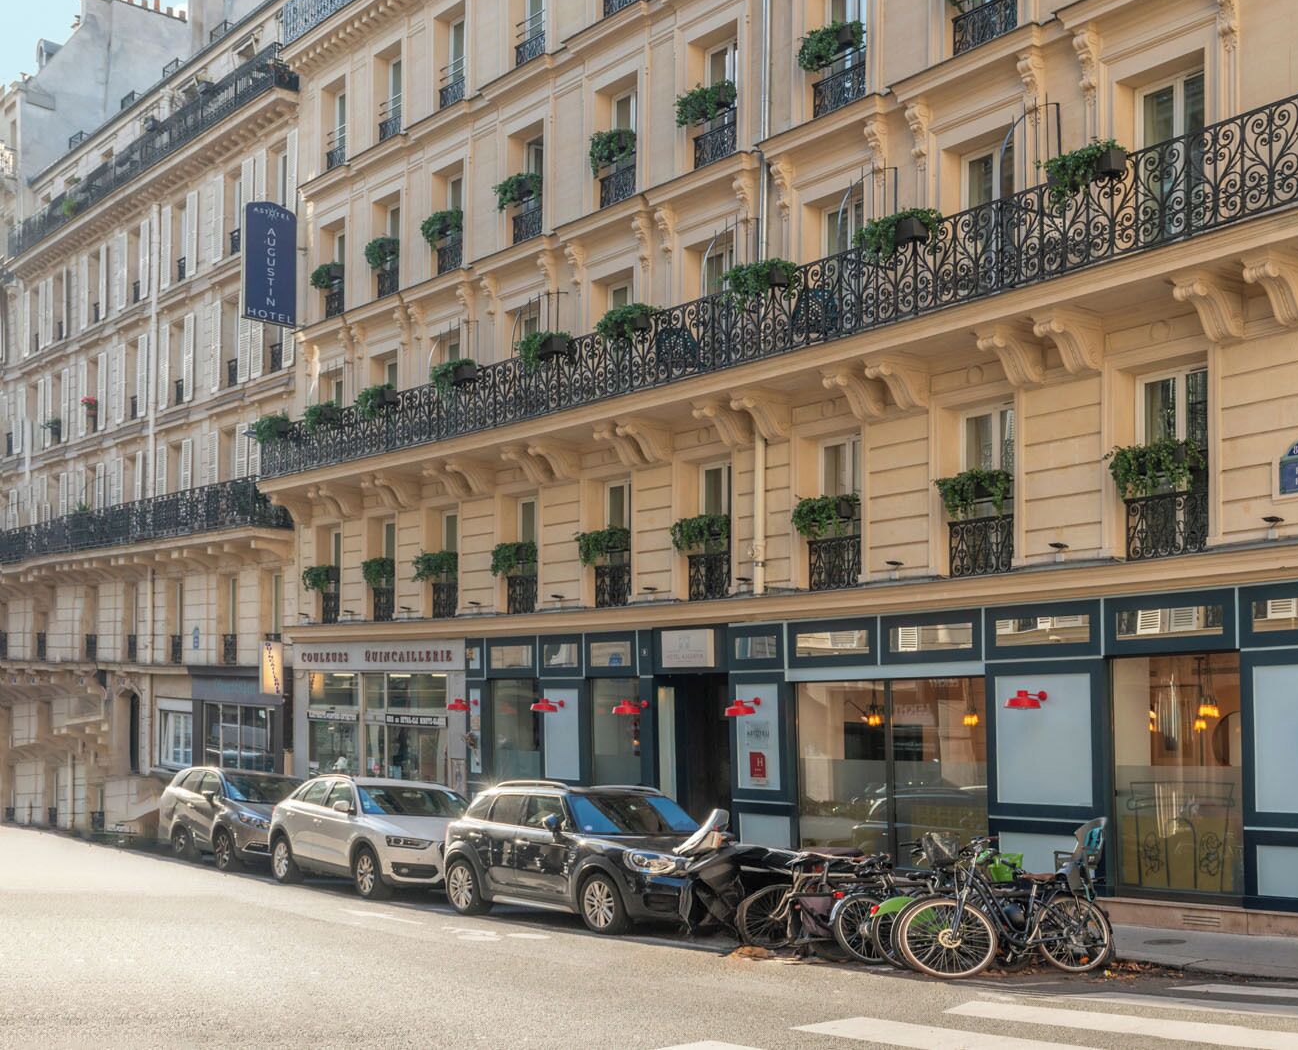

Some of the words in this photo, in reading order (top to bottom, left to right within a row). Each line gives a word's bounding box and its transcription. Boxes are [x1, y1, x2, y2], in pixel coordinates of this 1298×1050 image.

[253, 207, 290, 220] ASTOTEL
[267, 228, 276, 307] AUGUSTIN
[247, 307, 294, 325] HOTEL
[301, 652, 349, 662] COULEURS
[364, 650, 453, 662] QUINCAILLERIE
